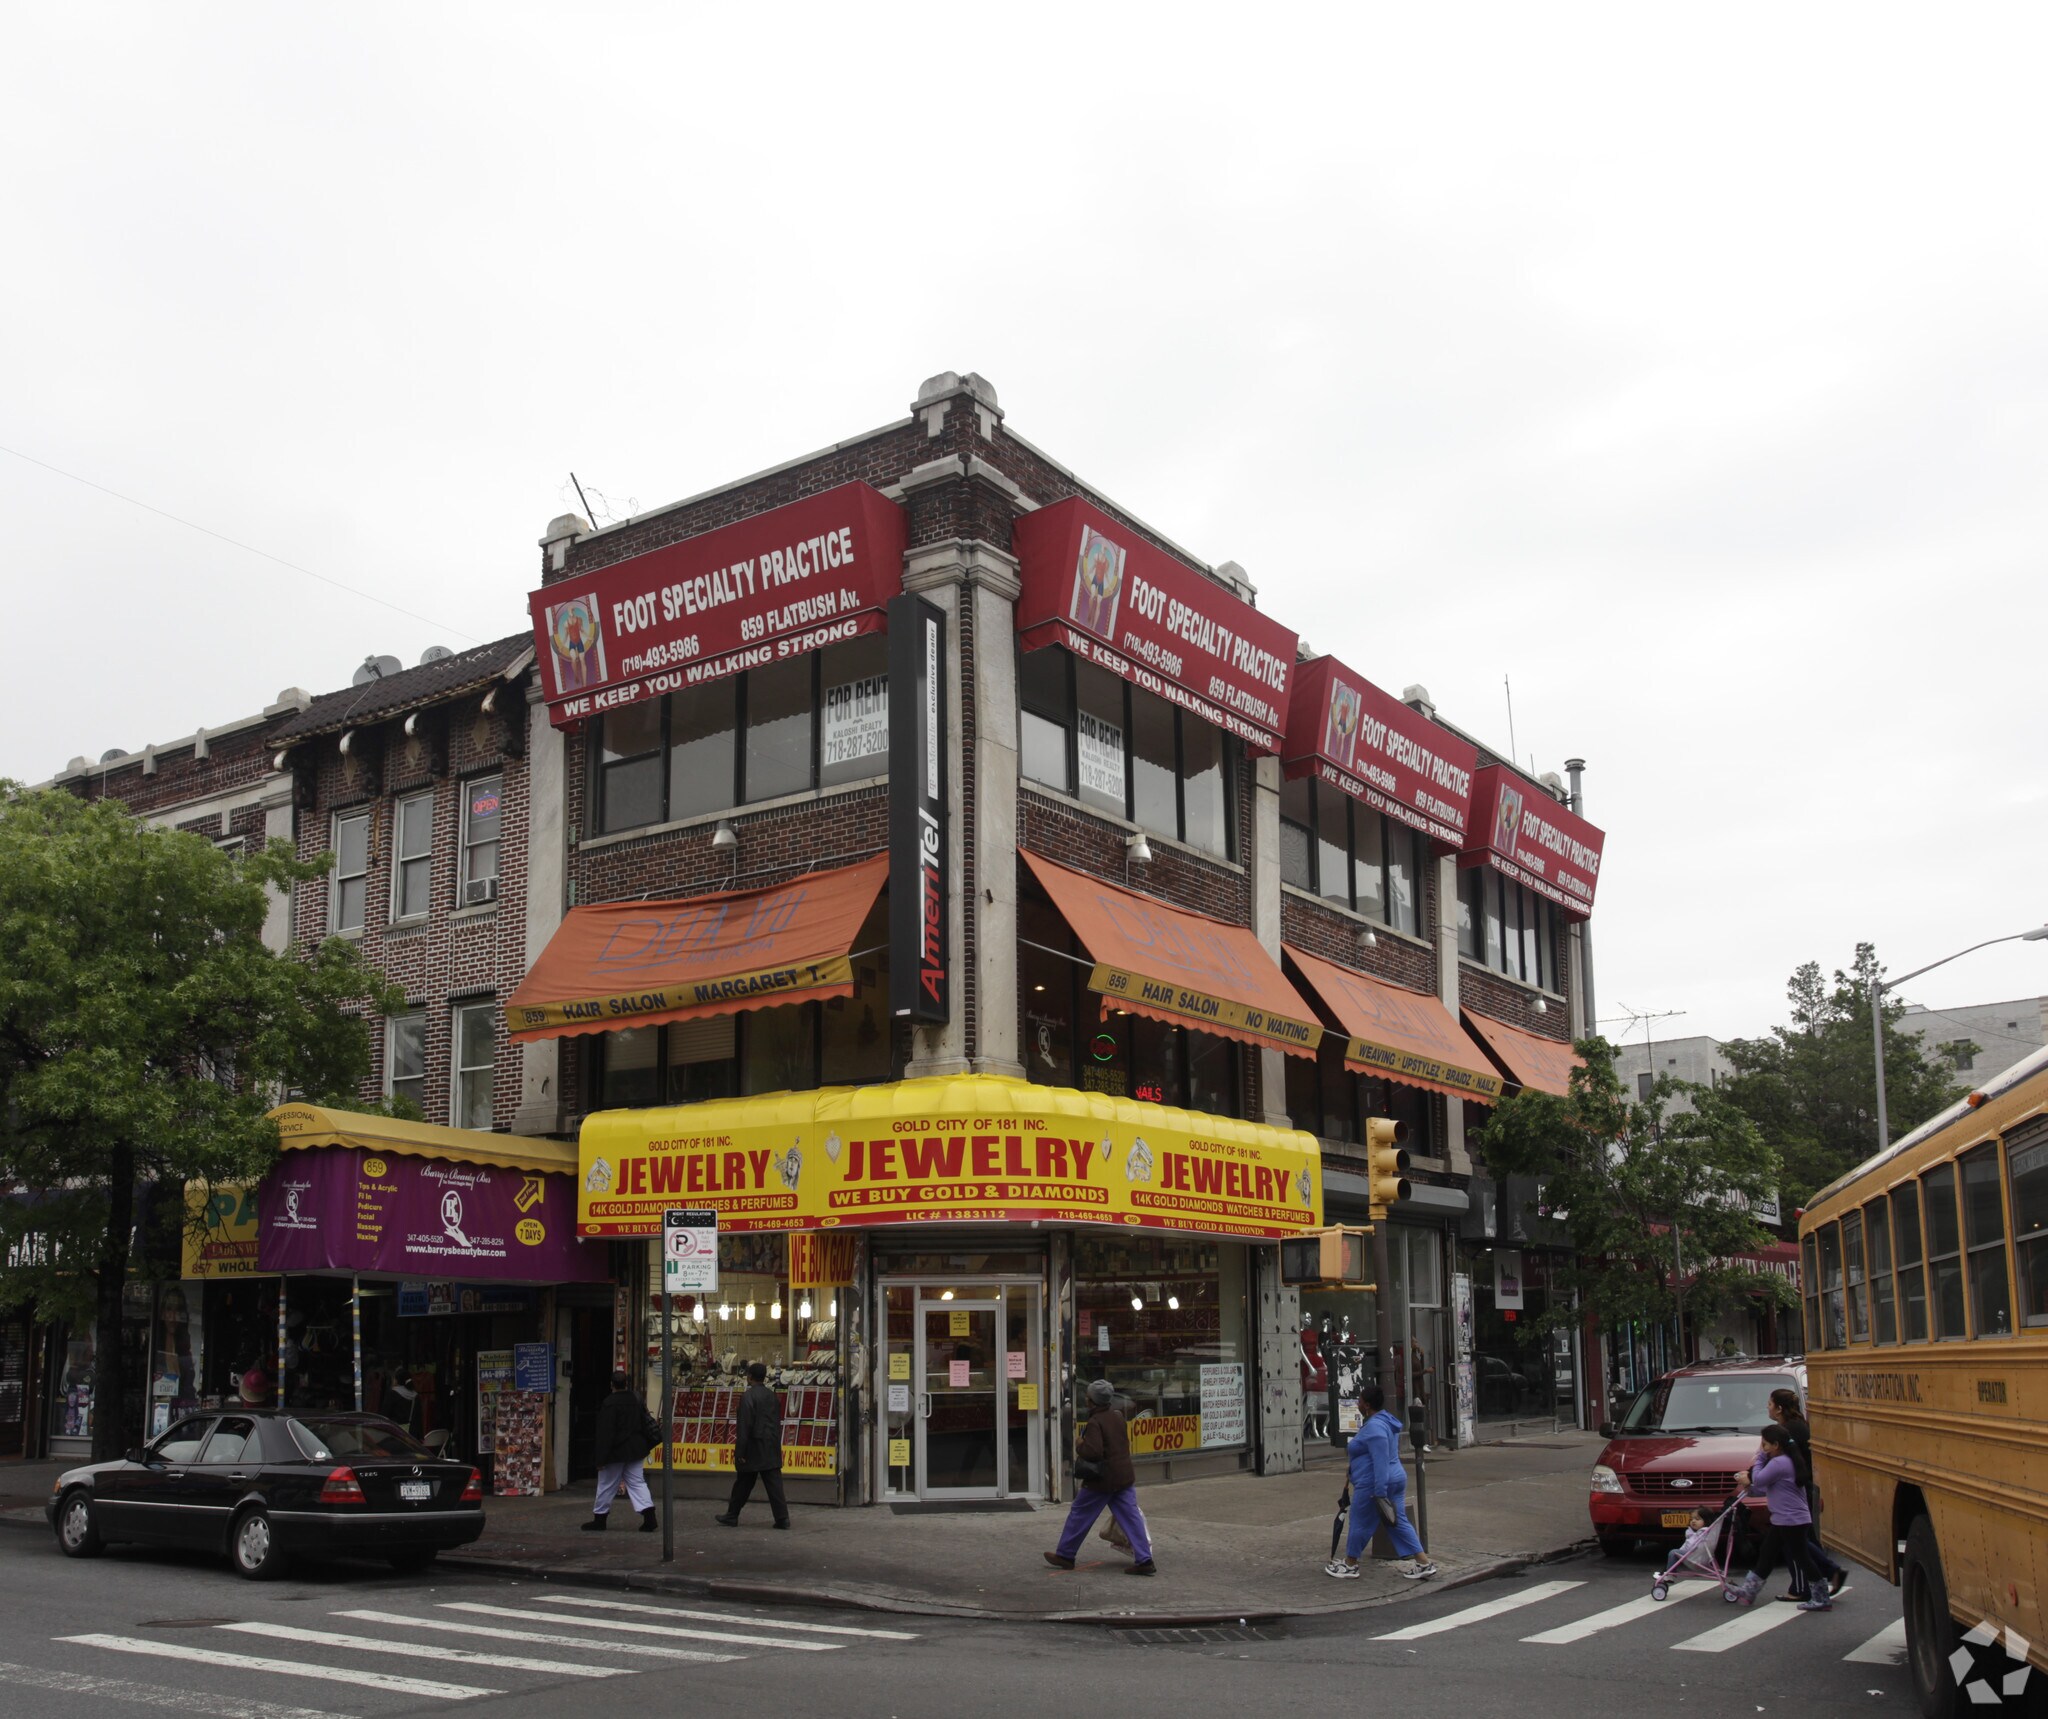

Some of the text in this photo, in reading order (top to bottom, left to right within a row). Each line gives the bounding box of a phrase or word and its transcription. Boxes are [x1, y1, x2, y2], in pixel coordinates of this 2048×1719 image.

[613, 527, 854, 637] FOOT SPECIALTY PRACTICE
[741, 588, 860, 641] 859 FLATBUSH Av.
[1130, 575, 1287, 693] FOOT SPECIALTY PRACTICE
[622, 634, 700, 676] (718)-493-5986
[1124, 632, 1183, 677] (718)-493-5986
[564, 620, 857, 717] WE KEEP YOU WALKING STRONG
[827, 674, 888, 724] FOR RENT
[1068, 630, 1272, 747] WE KEEP YOU WALKING STRONG
[1208, 676, 1268, 721] 859 FLATBUSH
[833, 720, 883, 739] KALOSHI REALTY
[827, 728, 888, 763] 718-287-5200
[1361, 713, 1470, 799] FOOT SPECIALTY PRACTICE
[473, 797, 498, 814] OPEN
[1322, 764, 1463, 845] WE KEEP YOU WALKING STRONG
[1415, 789, 1456, 824] 859 FLATBUSH
[1521, 810, 1599, 875] FOOT SPECIALTY PRACTICE
[1501, 859, 1519, 876] KEEP
[1520, 869, 1534, 885] YOU
[1534, 878, 1562, 901] WALKING
[919, 807, 945, 1003] AmeriTel
[525, 966, 827, 1023] 859 HAIR SALON MARGARET T.
[1109, 973, 1310, 1041] 859 HAIR SALON NO WAITING
[1359, 1044, 1497, 1093] WEAVING UPSTYLEZ BRAIDZ NAILZ
[1136, 1086, 1162, 1102] NAILS
[275, 1111, 316, 1123] OFESSIONAL
[280, 1123, 304, 1133] ERVICE
[892, 1119, 1048, 1133] GOLD CITY OF 181 INC.
[648, 1136, 733, 1151] GOLD CITY OF 181 INC.
[366, 1160, 384, 1173] 859
[843, 1136, 1095, 1181] JEWELRY
[615, 1149, 771, 1195] JEWELRY
[1160, 1152, 1290, 1203] JEWELRY
[377, 1184, 398, 1192] Acrylic
[833, 1185, 1105, 1206] WE BUY GOLD & DIAMONDS
[592, 1197, 794, 1215] 14K GOLD DIAMONDS WATCHES & PERFUMES
[906, 1210, 1005, 1220] LIC 1383112
[1058, 1211, 1113, 1222] 718-469-4653
[1135, 1193, 1310, 1223] 14K GOLD DIAMONDS WATCHES & PERFUMES
[523, 1221, 538, 1229] OPEN
[617, 1224, 649, 1233] WE BUY
[748, 1218, 804, 1229] 718-469-4653
[825, 1218, 836, 1226] 859
[1163, 1218, 1265, 1236] WE BUY GOLD & DIAMONDS
[520, 1230, 541, 1241] 7 DAYS
[405, 1244, 507, 1258] www.barrysbeautybar.com
[791, 1235, 855, 1284] WE BUY GOLD
[192, 1263, 212, 1274] 857
[1907, 1374, 1923, 1403] INC.
[1977, 1380, 2007, 1403] OPERATOR
[1153, 1433, 1184, 1450] ORO
[686, 1449, 707, 1464] GOLD
[719, 1449, 728, 1465] WE
[795, 1451, 826, 1468] WATCHES
